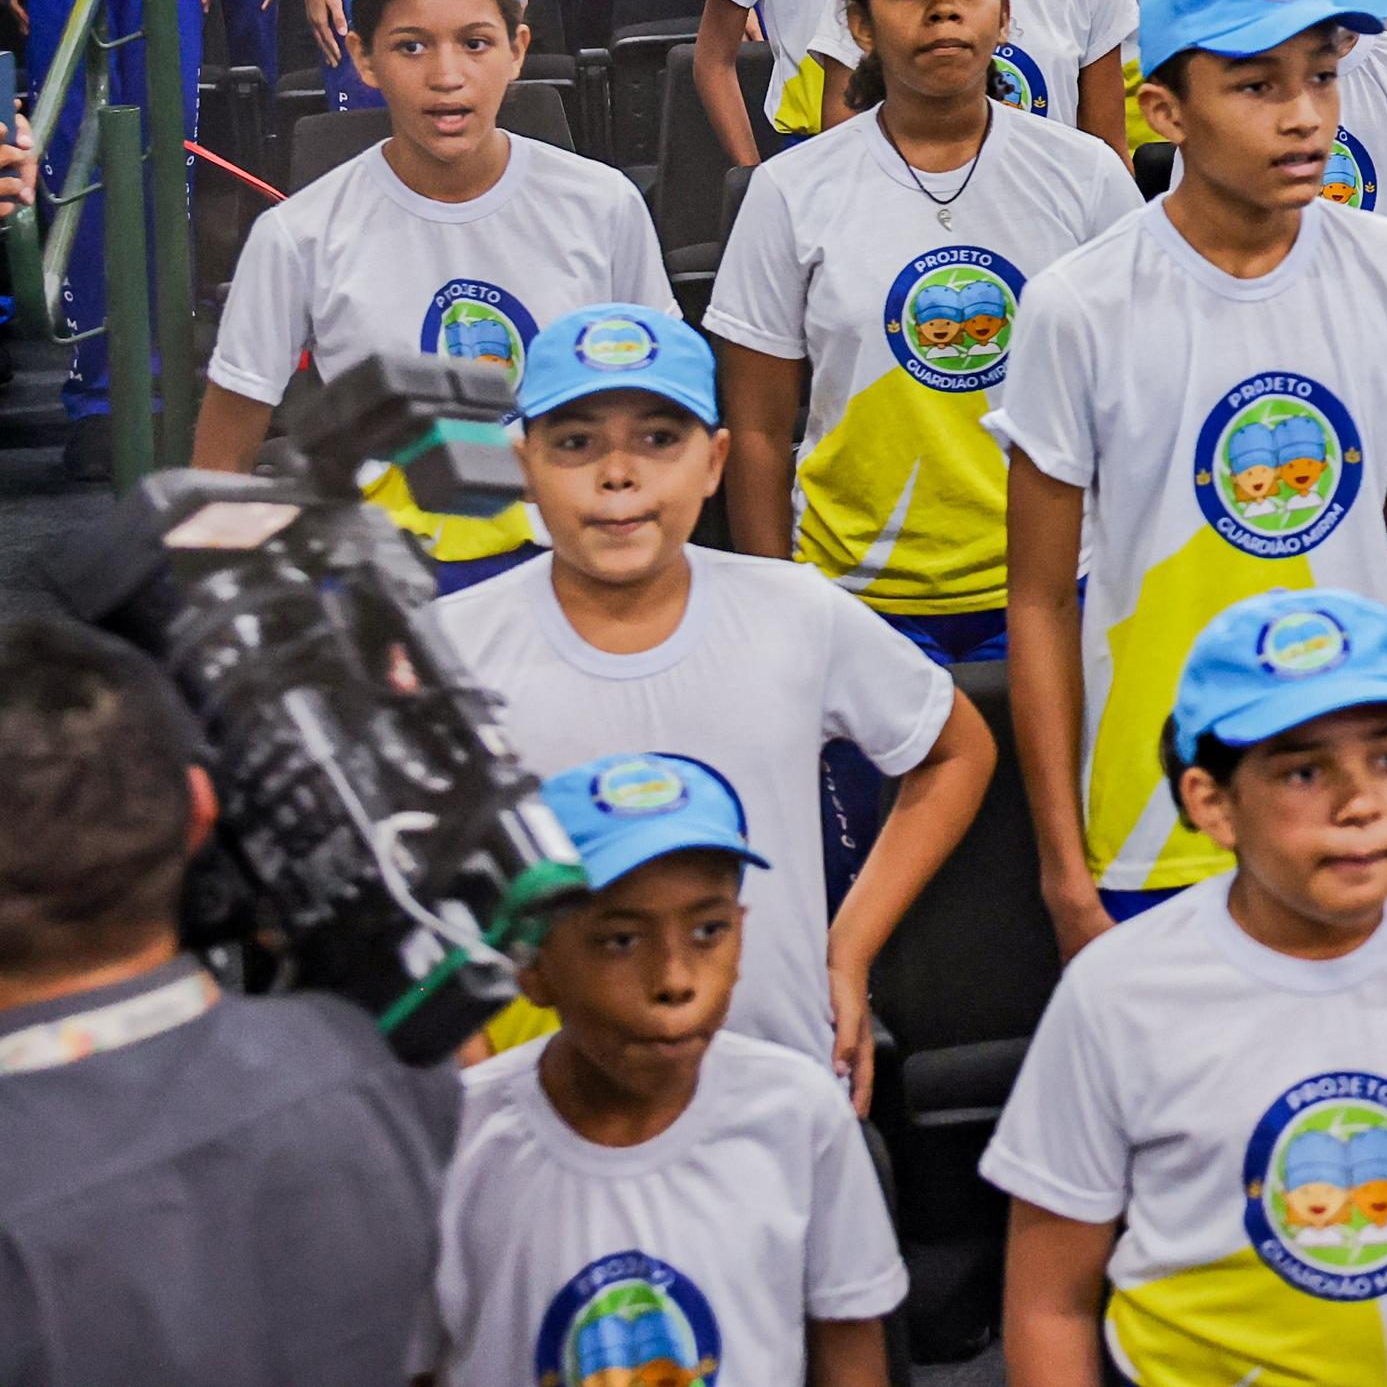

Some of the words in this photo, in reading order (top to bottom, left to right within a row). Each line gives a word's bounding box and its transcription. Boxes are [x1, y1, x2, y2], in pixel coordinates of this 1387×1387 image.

[914, 249, 993, 273] PROJETO
[906, 360, 979, 389] GUARDIÃO
[1227, 379, 1312, 408] PROJETO
[1215, 515, 1301, 556] GUARDIÃO
[1300, 503, 1344, 545] MIRIM
